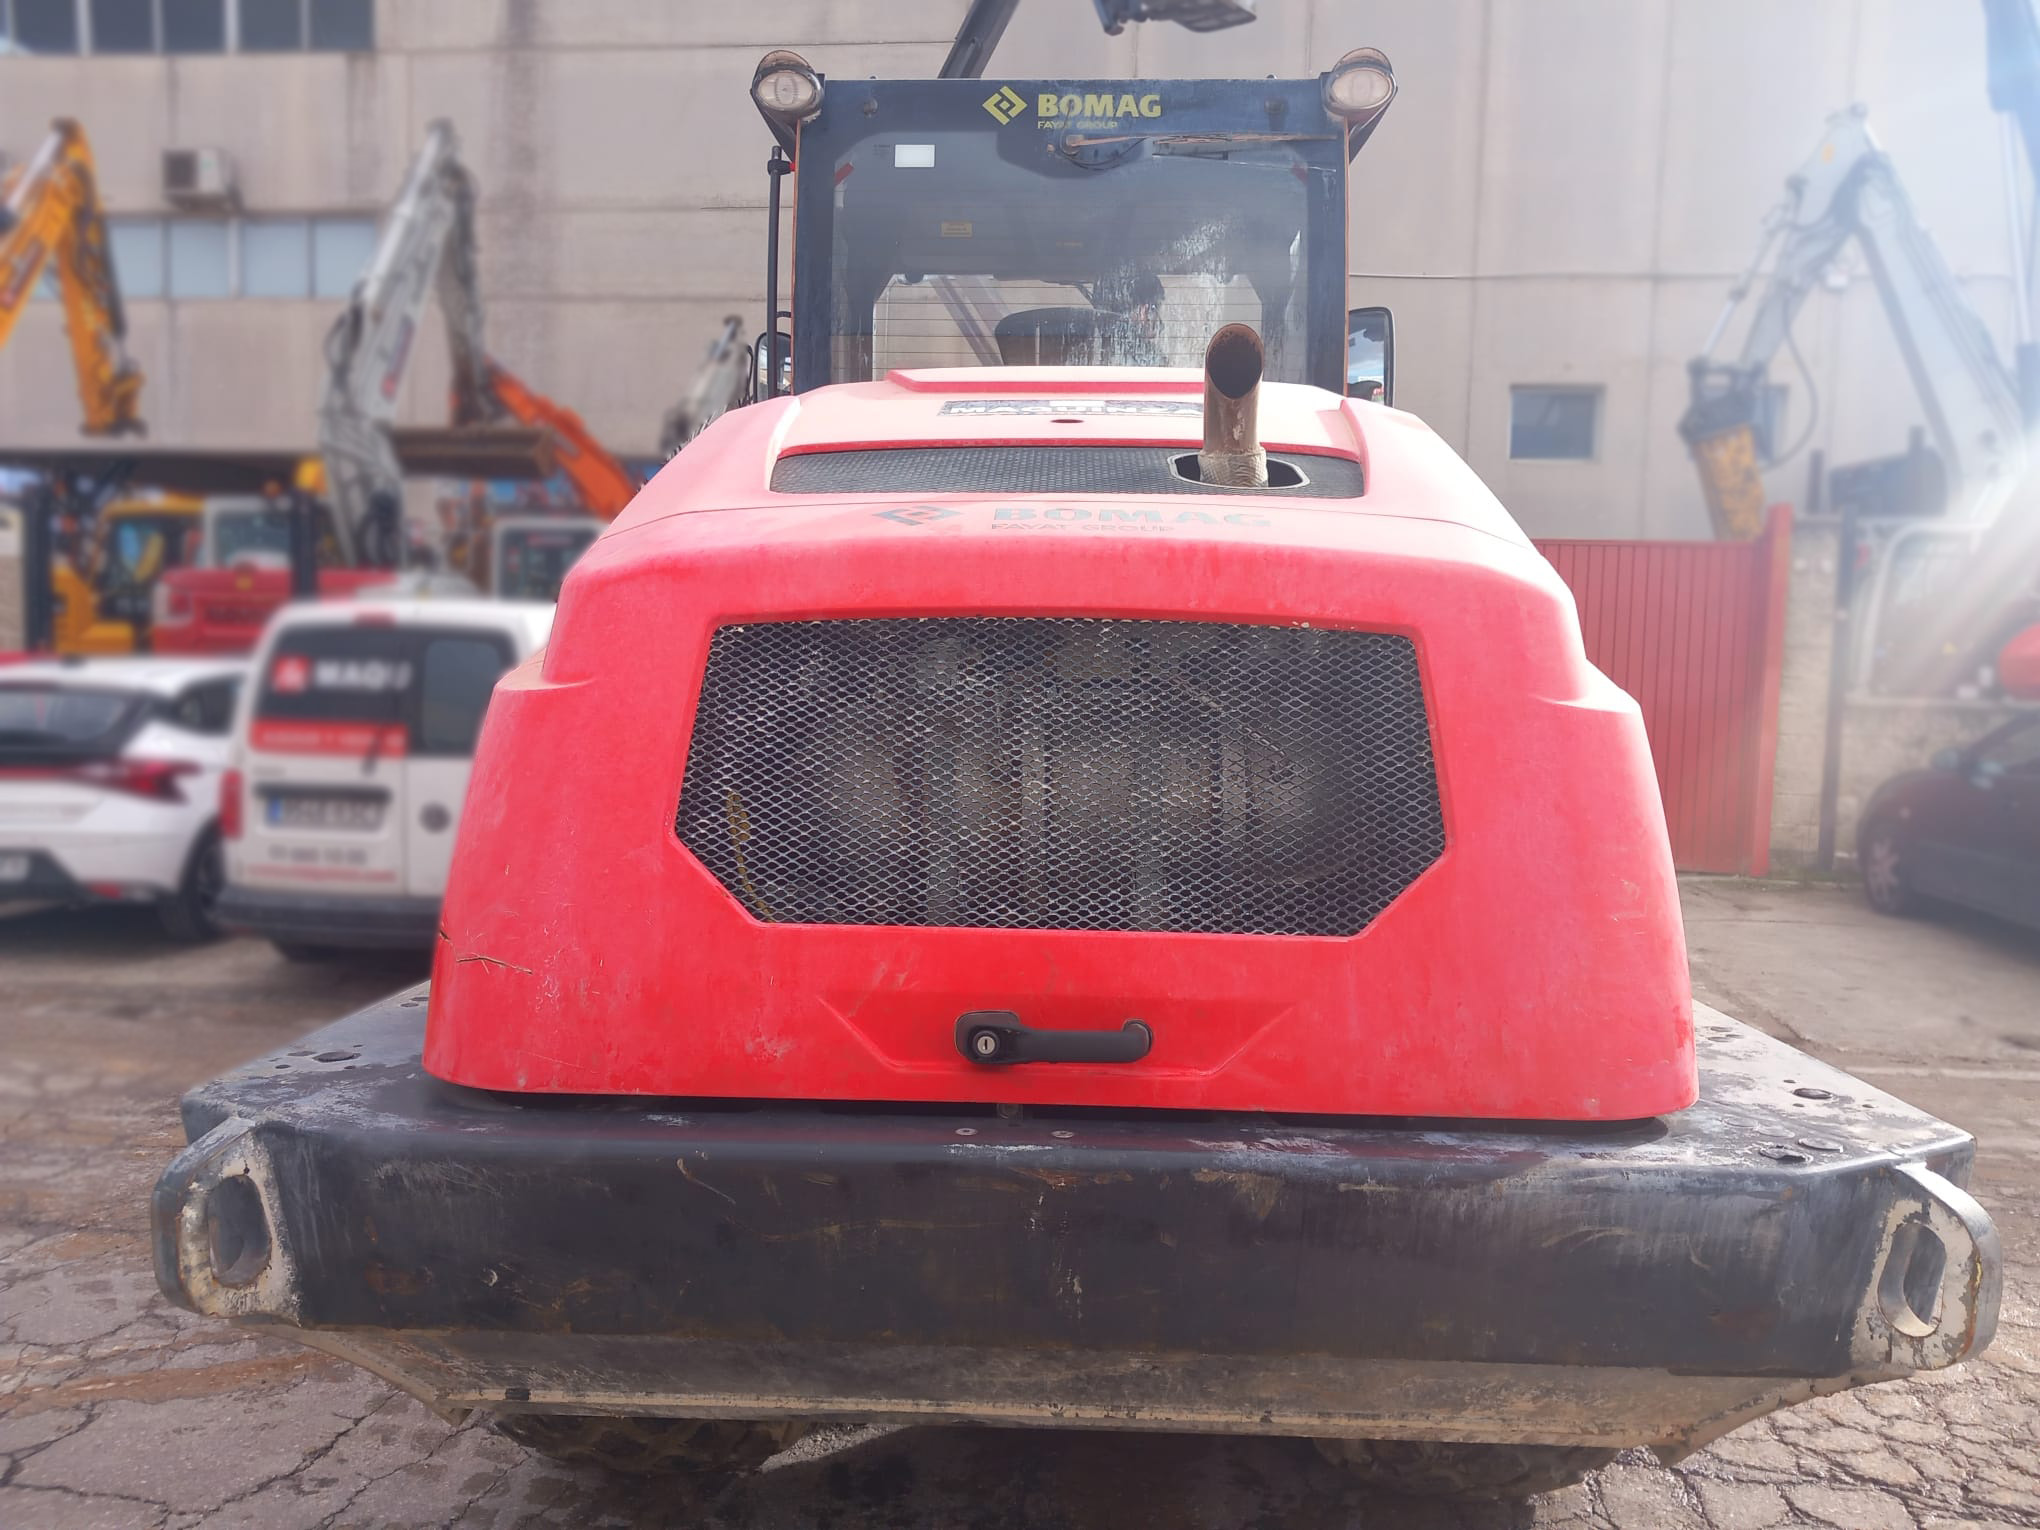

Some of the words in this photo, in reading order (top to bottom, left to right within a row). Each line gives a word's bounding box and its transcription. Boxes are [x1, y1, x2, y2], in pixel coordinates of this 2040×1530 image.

[1037, 93, 1162, 118] BOMAG
[1076, 120, 1118, 130] GROUP
[993, 507, 1273, 527] BOMAG
[991, 523, 1072, 531] FAYAT
[1082, 524, 1175, 533] GROUP
